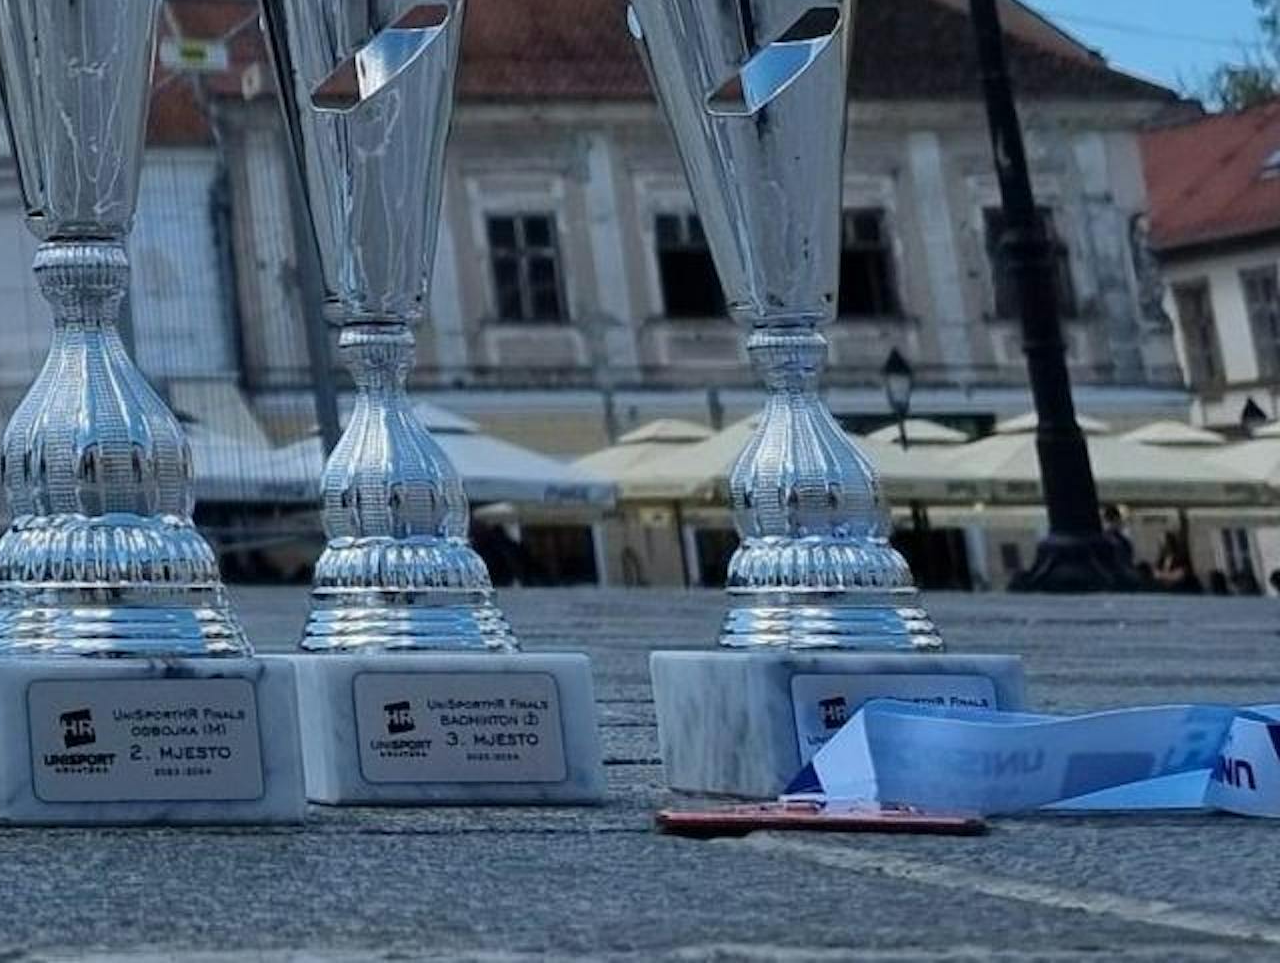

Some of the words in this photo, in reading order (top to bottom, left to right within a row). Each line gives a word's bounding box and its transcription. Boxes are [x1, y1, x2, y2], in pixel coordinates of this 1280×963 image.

[440, 714, 519, 727] BADMINTON
[131, 725, 198, 737] ODBOJKA
[370, 740, 432, 750] UNISPORT
[447, 732, 466, 747] 3.
[474, 733, 539, 746] MJESTO
[129, 744, 150, 761] 2.
[160, 746, 231, 759] MJESTO
[44, 753, 116, 765] UNISPORT
